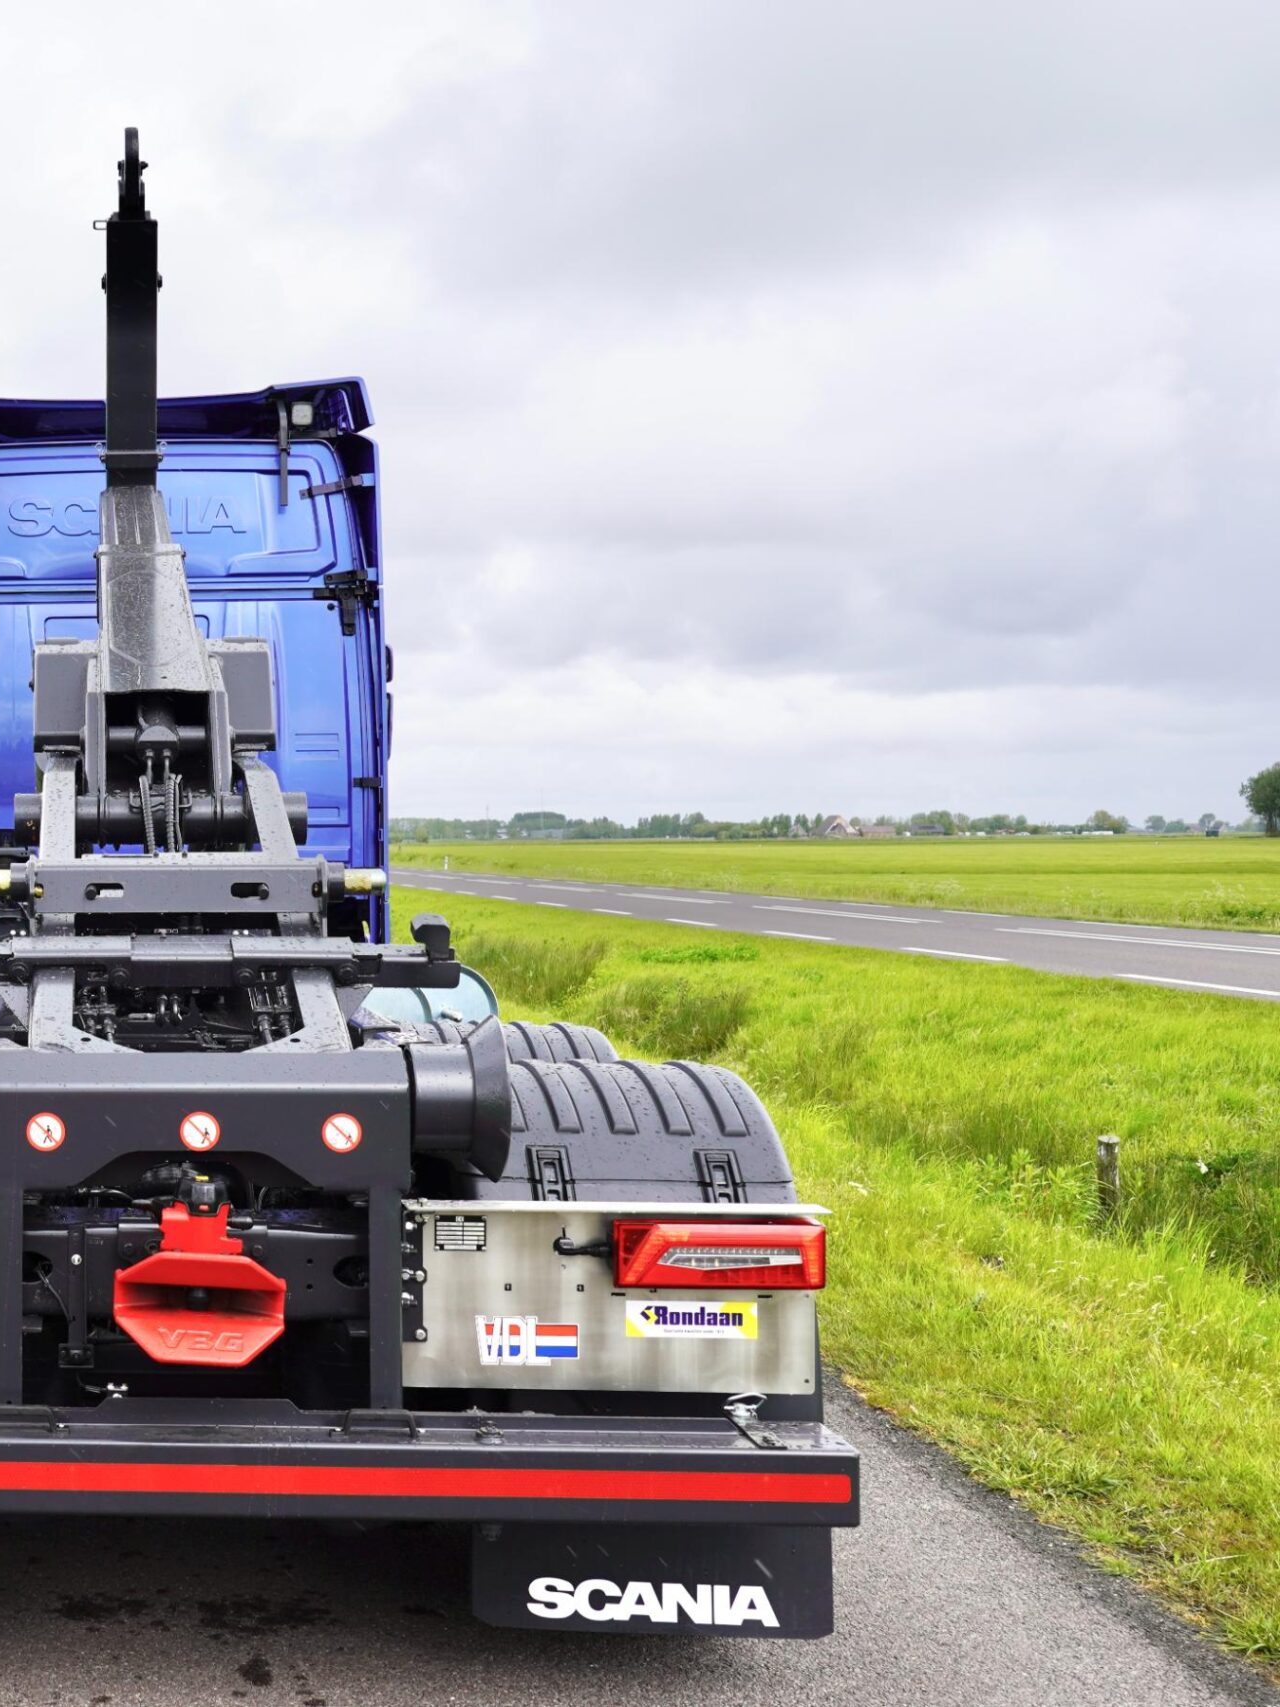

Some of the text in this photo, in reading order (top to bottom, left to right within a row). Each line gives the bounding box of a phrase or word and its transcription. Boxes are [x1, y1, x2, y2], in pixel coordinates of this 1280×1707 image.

[8, 497, 247, 537] SCIA
[654, 1305, 743, 1327] Rondaan
[157, 1327, 245, 1352] VBG
[475, 1315, 551, 1366] VDL
[526, 1576, 781, 1628] SCANIA
